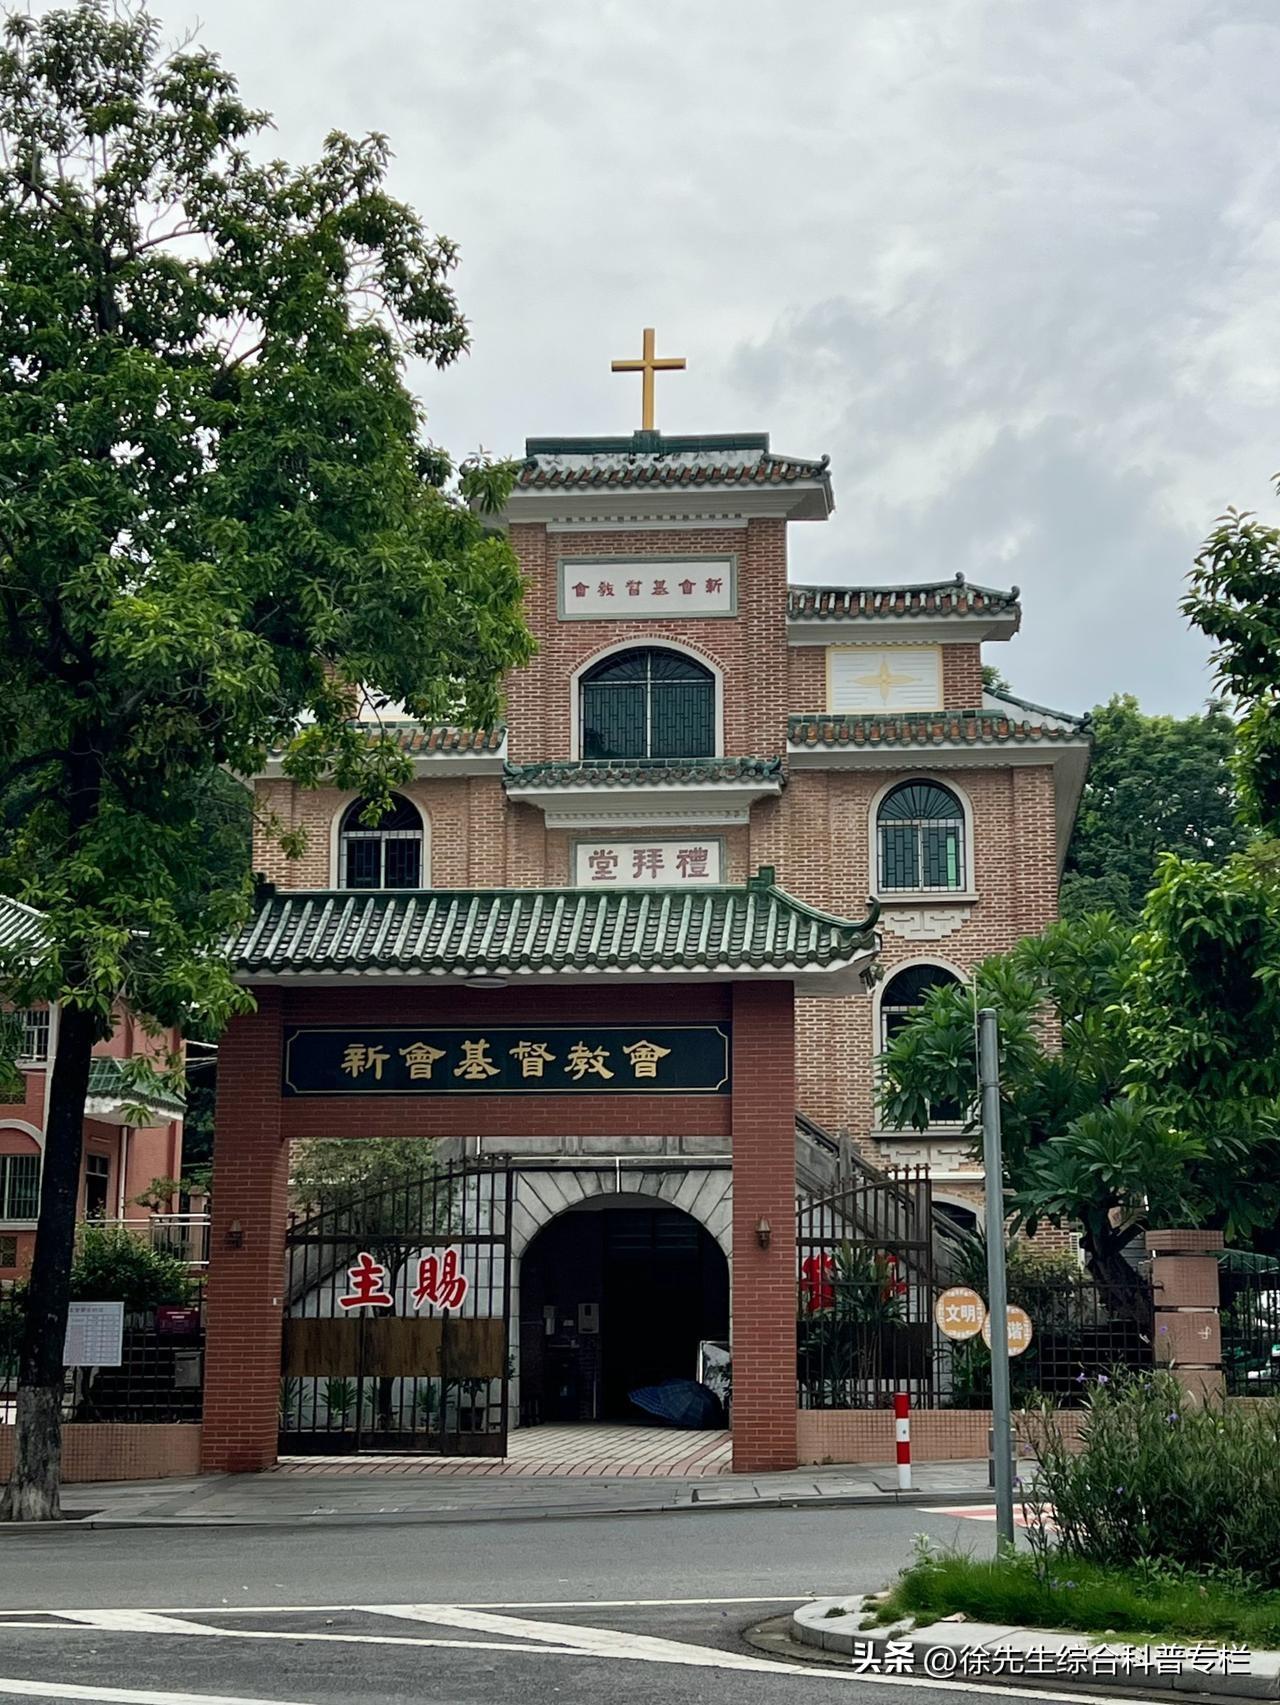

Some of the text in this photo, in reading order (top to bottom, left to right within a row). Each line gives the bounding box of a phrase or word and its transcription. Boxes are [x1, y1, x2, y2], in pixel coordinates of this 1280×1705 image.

[340, 1039, 671, 1080] 新會基督教會
[338, 1249, 468, 1309] 主賜
[945, 1304, 976, 1323] 文明
